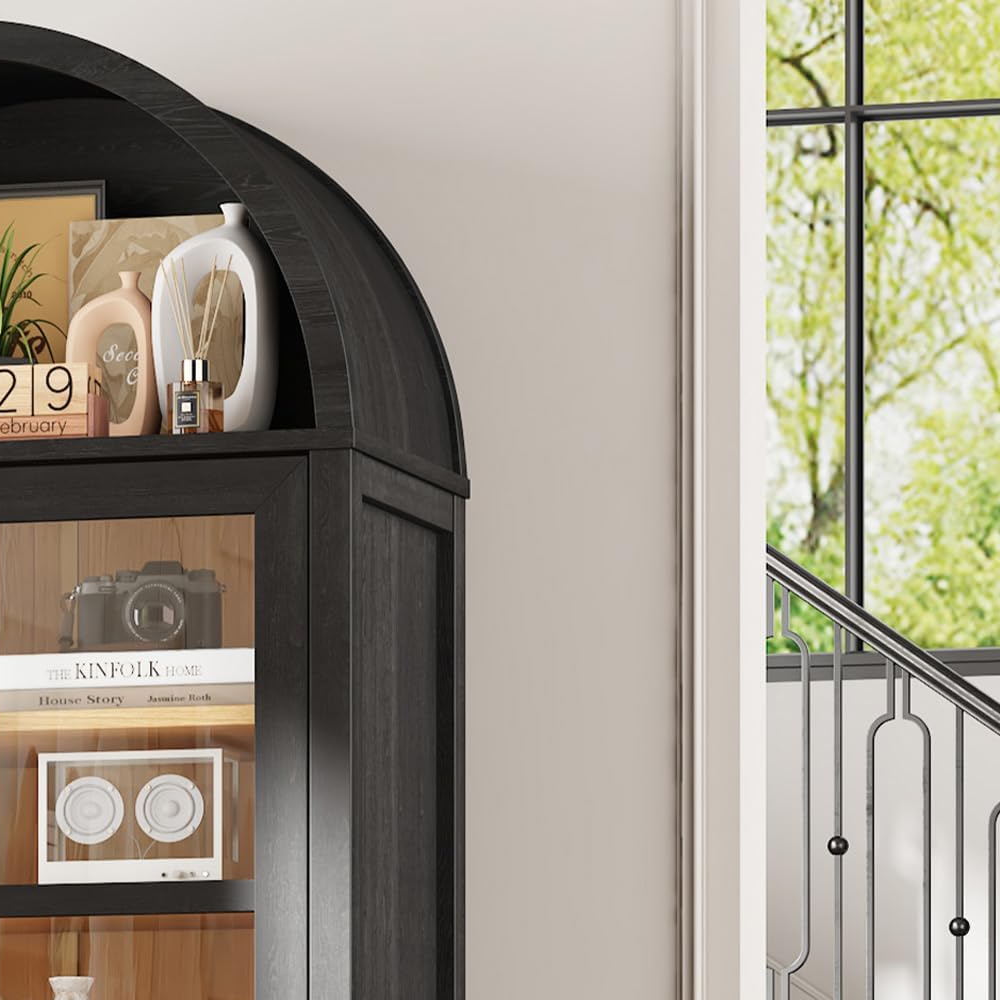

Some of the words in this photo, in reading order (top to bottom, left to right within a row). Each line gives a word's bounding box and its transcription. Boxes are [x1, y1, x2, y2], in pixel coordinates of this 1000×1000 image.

[75, 661, 160, 679] KINFOLK
[165, 665, 203, 677] HOME
[39, 696, 82, 706] House
[86, 694, 125, 706] Story
[188, 693, 212, 701] Roth
